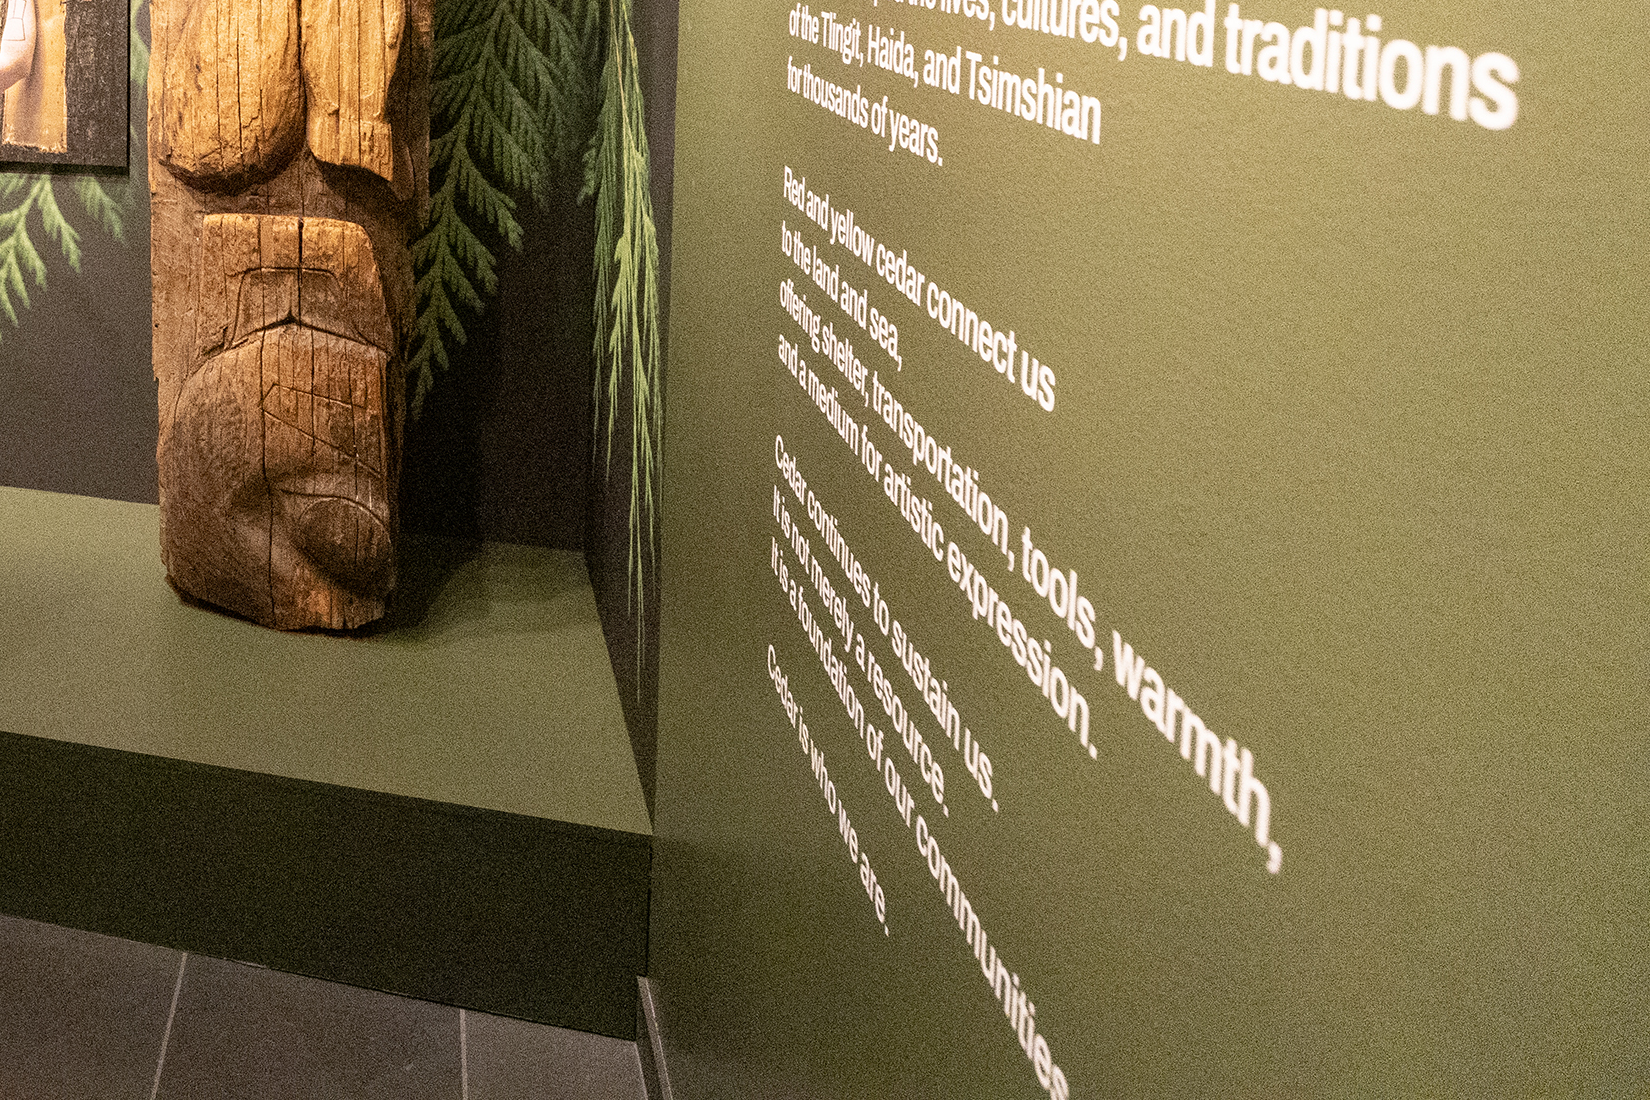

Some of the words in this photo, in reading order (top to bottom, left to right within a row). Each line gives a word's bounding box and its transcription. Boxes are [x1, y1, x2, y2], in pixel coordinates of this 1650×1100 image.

[787, 55, 802, 95] for
[802, 63, 869, 129] thousands
[871, 95, 888, 138] of
[888, 108, 943, 167] years.
[788, 2, 801, 37] of
[801, 4, 819, 45] the
[820, 10, 864, 68] Tlingit,
[867, 24, 919, 89] Haida,
[923, 46, 962, 94] and
[966, 50, 1102, 145] Tsimshian
[1225, 2, 1522, 131] traditions
[781, 220, 793, 257] to
[793, 230, 811, 275] the
[812, 245, 840, 303] land
[840, 281, 868, 331] and
[869, 307, 902, 372] sea,
[783, 165, 806, 212] Red
[806, 190, 830, 231] and
[830, 206, 875, 267] yellow
[875, 243, 925, 307] cedar
[926, 281, 1018, 384] connect
[1020, 350, 1056, 413] us
[772, 484, 780, 523] It
[781, 496, 791, 539] is
[791, 522, 810, 574] not
[811, 555, 854, 654] merely
[855, 633, 866, 673] a
[867, 651, 949, 818] resource.
[775, 435, 807, 506] Cedar
[807, 490, 871, 608] continues
[873, 582, 890, 636] to
[891, 620, 960, 751] sustain
[964, 727, 999, 813] us.
[778, 334, 799, 378] and
[799, 359, 807, 390] a
[807, 368, 859, 456] medium
[861, 424, 883, 483] for
[883, 463, 945, 562] artistic
[947, 541, 1098, 760] expression.
[779, 278, 821, 354] offering
[821, 322, 869, 408] shelter,
[872, 370, 1015, 573] transportation,
[1021, 526, 1104, 671] tools,
[1112, 629, 1283, 874] warmth,
[767, 644, 799, 729] Cedar
[799, 705, 809, 755] is
[810, 738, 837, 815] who
[838, 799, 859, 864] we
[860, 852, 890, 937] are.
[771, 536, 778, 576] It
[779, 550, 789, 593] is
[789, 579, 797, 611] a
[797, 585, 864, 739] foundation
[867, 723, 884, 771] of
[884, 757, 915, 828] our
[916, 814, 1069, 1100] communities
